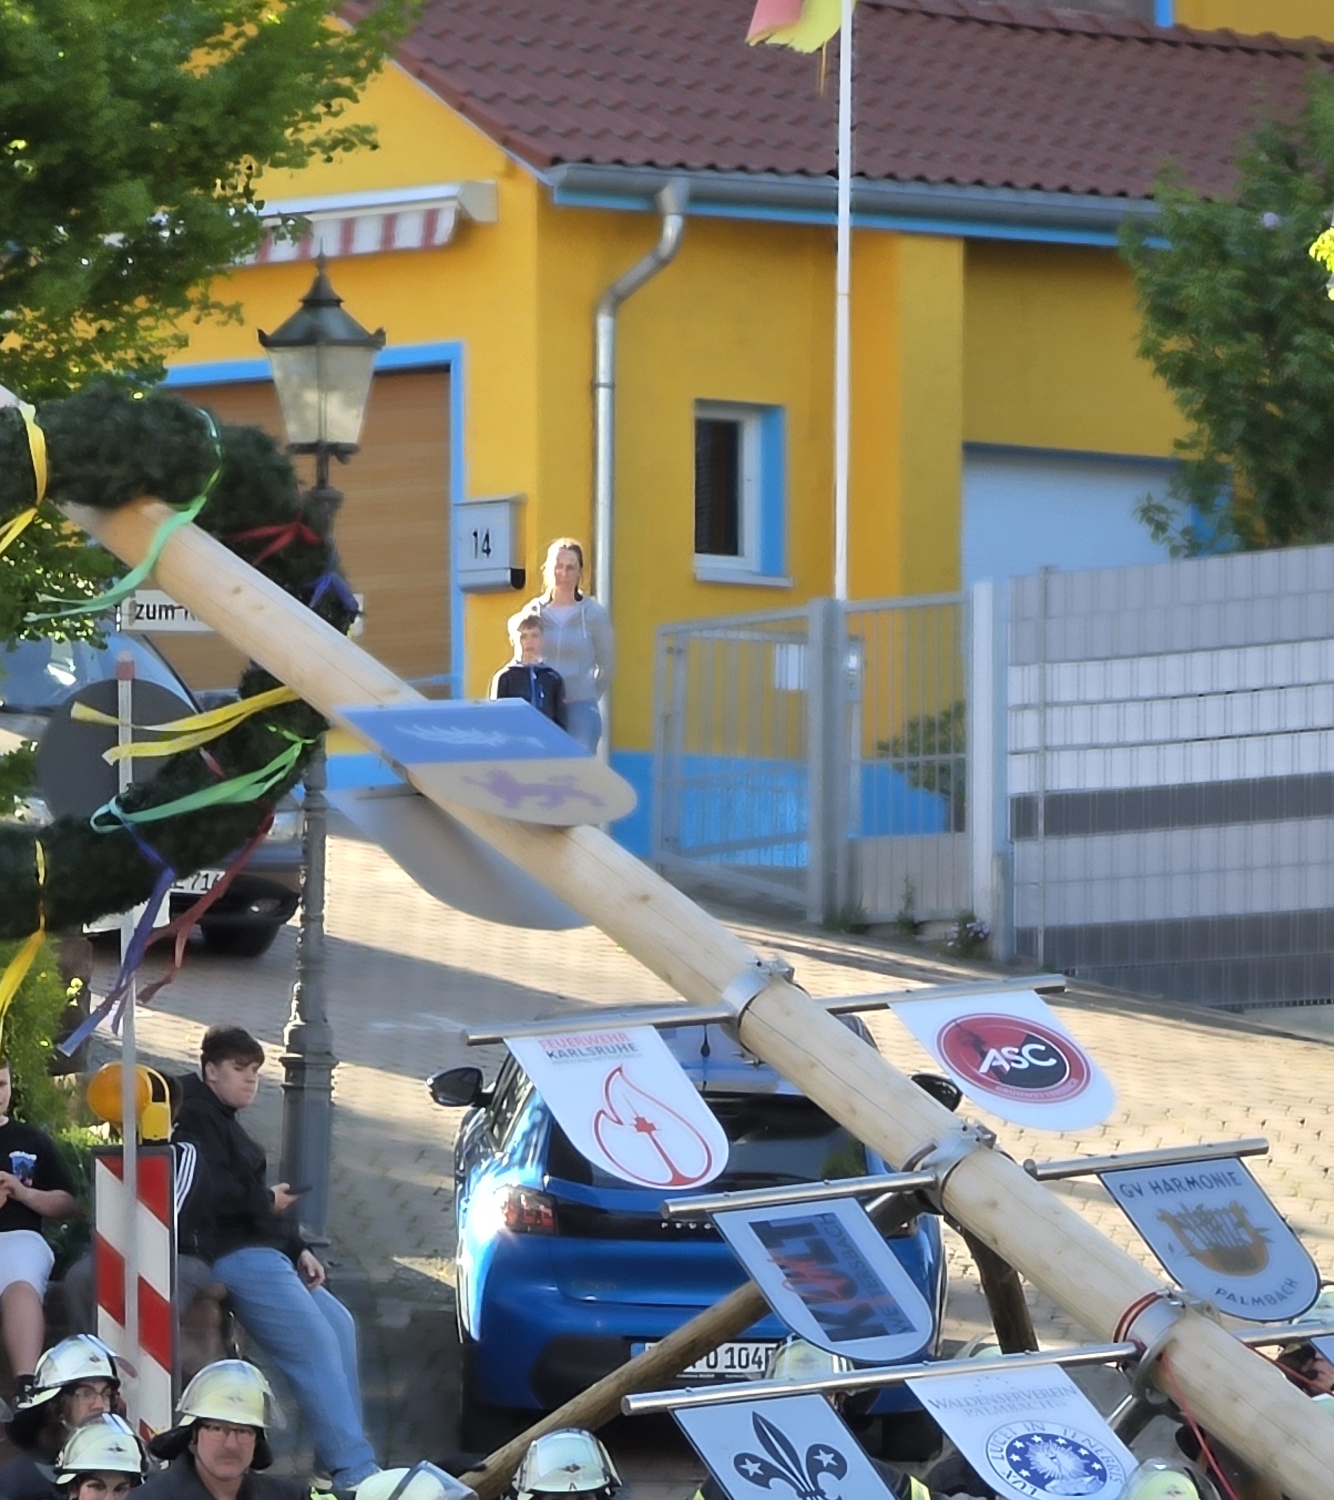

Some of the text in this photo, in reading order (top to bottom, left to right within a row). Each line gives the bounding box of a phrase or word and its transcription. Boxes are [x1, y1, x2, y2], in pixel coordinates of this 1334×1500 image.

[472, 528, 492, 560] 14
[135, 603, 175, 621] zum
[538, 1031, 631, 1050] FEUERWEHR
[545, 1042, 640, 1060] KARLSRUHE
[978, 1043, 1058, 1074] ASC
[1119, 1170, 1243, 1199] GV HARMONIE
[1214, 1276, 1300, 1308] PALMBACH
[988, 1425, 1018, 1461] LUCET
[1022, 1421, 1047, 1432] IN
[1062, 1428, 1124, 1484] TENEBRIS
